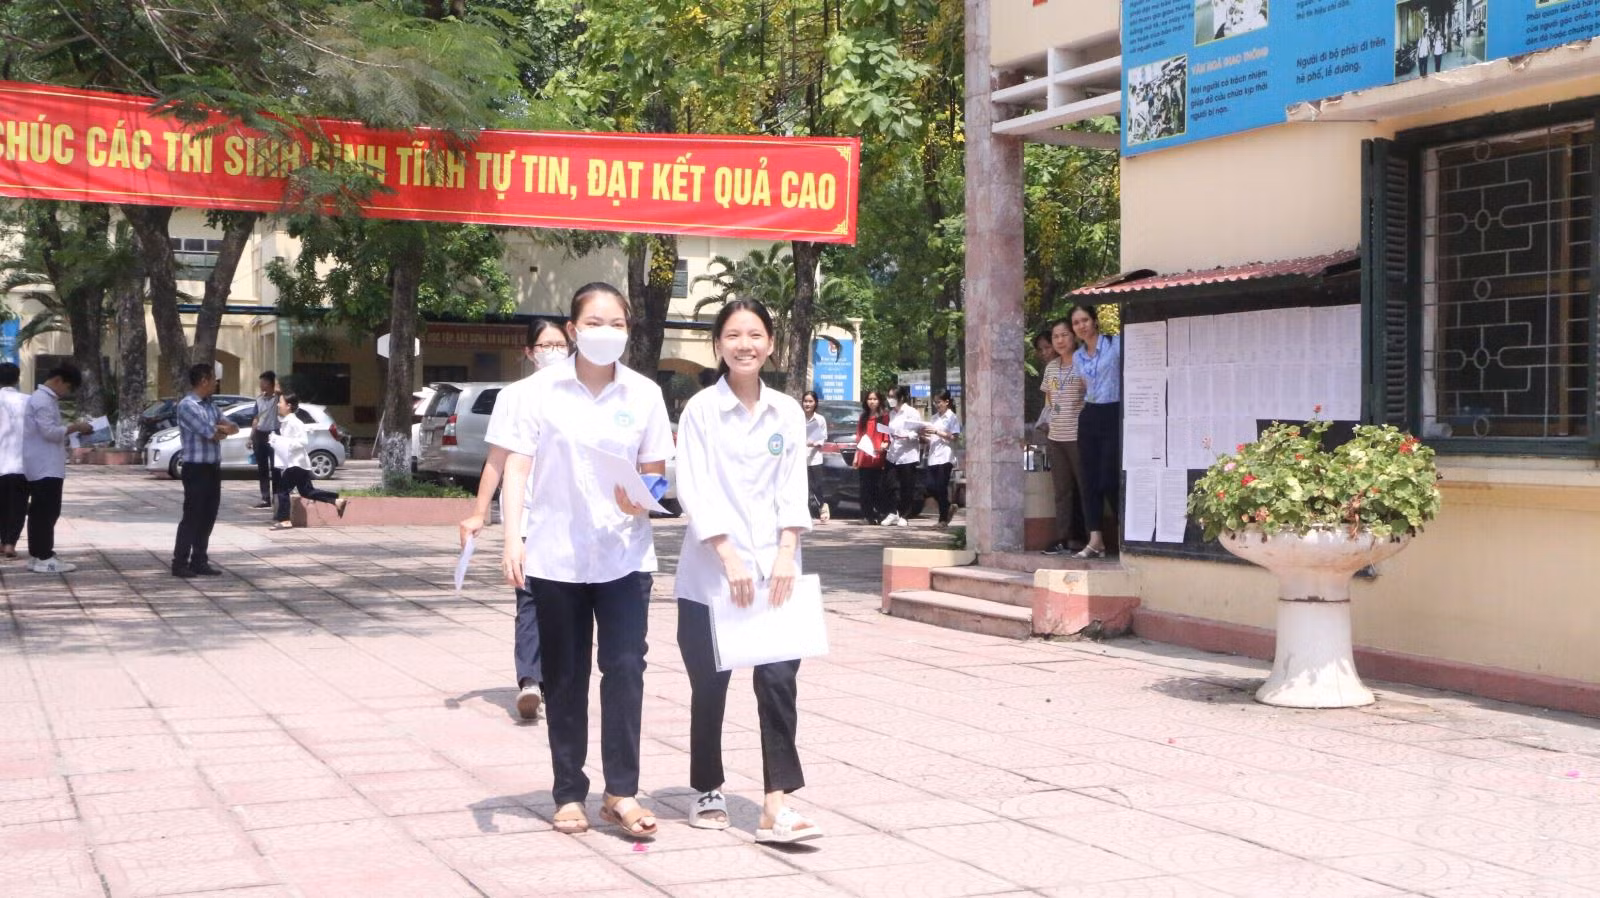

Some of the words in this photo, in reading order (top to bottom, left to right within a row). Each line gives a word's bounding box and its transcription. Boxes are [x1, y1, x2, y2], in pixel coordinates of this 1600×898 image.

[1296, 54, 1318, 69] Người
[1319, 51, 1328, 63] đi
[1329, 47, 1339, 60] bộ
[1340, 44, 1358, 57] phải
[1360, 40, 1369, 52] đi
[1370, 36, 1386, 49] trên
[1203, 80, 1220, 93] người
[1221, 77, 1229, 87] có
[1230, 74, 1247, 85] trách
[1248, 69, 1268, 81] nhiệm
[1296, 73, 1306, 85] hè
[1307, 67, 1324, 83] phố,
[1334, 61, 1361, 75] đường.
[0, 114, 74, 165] HÚC
[86, 120, 152, 170] CÁC
[224, 136, 301, 178] SINH
[396, 140, 465, 189] TĨNH
[476, 150, 516, 200] TỰ
[522, 154, 577, 200] TIN,
[587, 159, 643, 206] ĐẠT
[652, 152, 706, 202] KẾT
[714, 157, 771, 208] QUẢ
[781, 171, 836, 211] CAO
